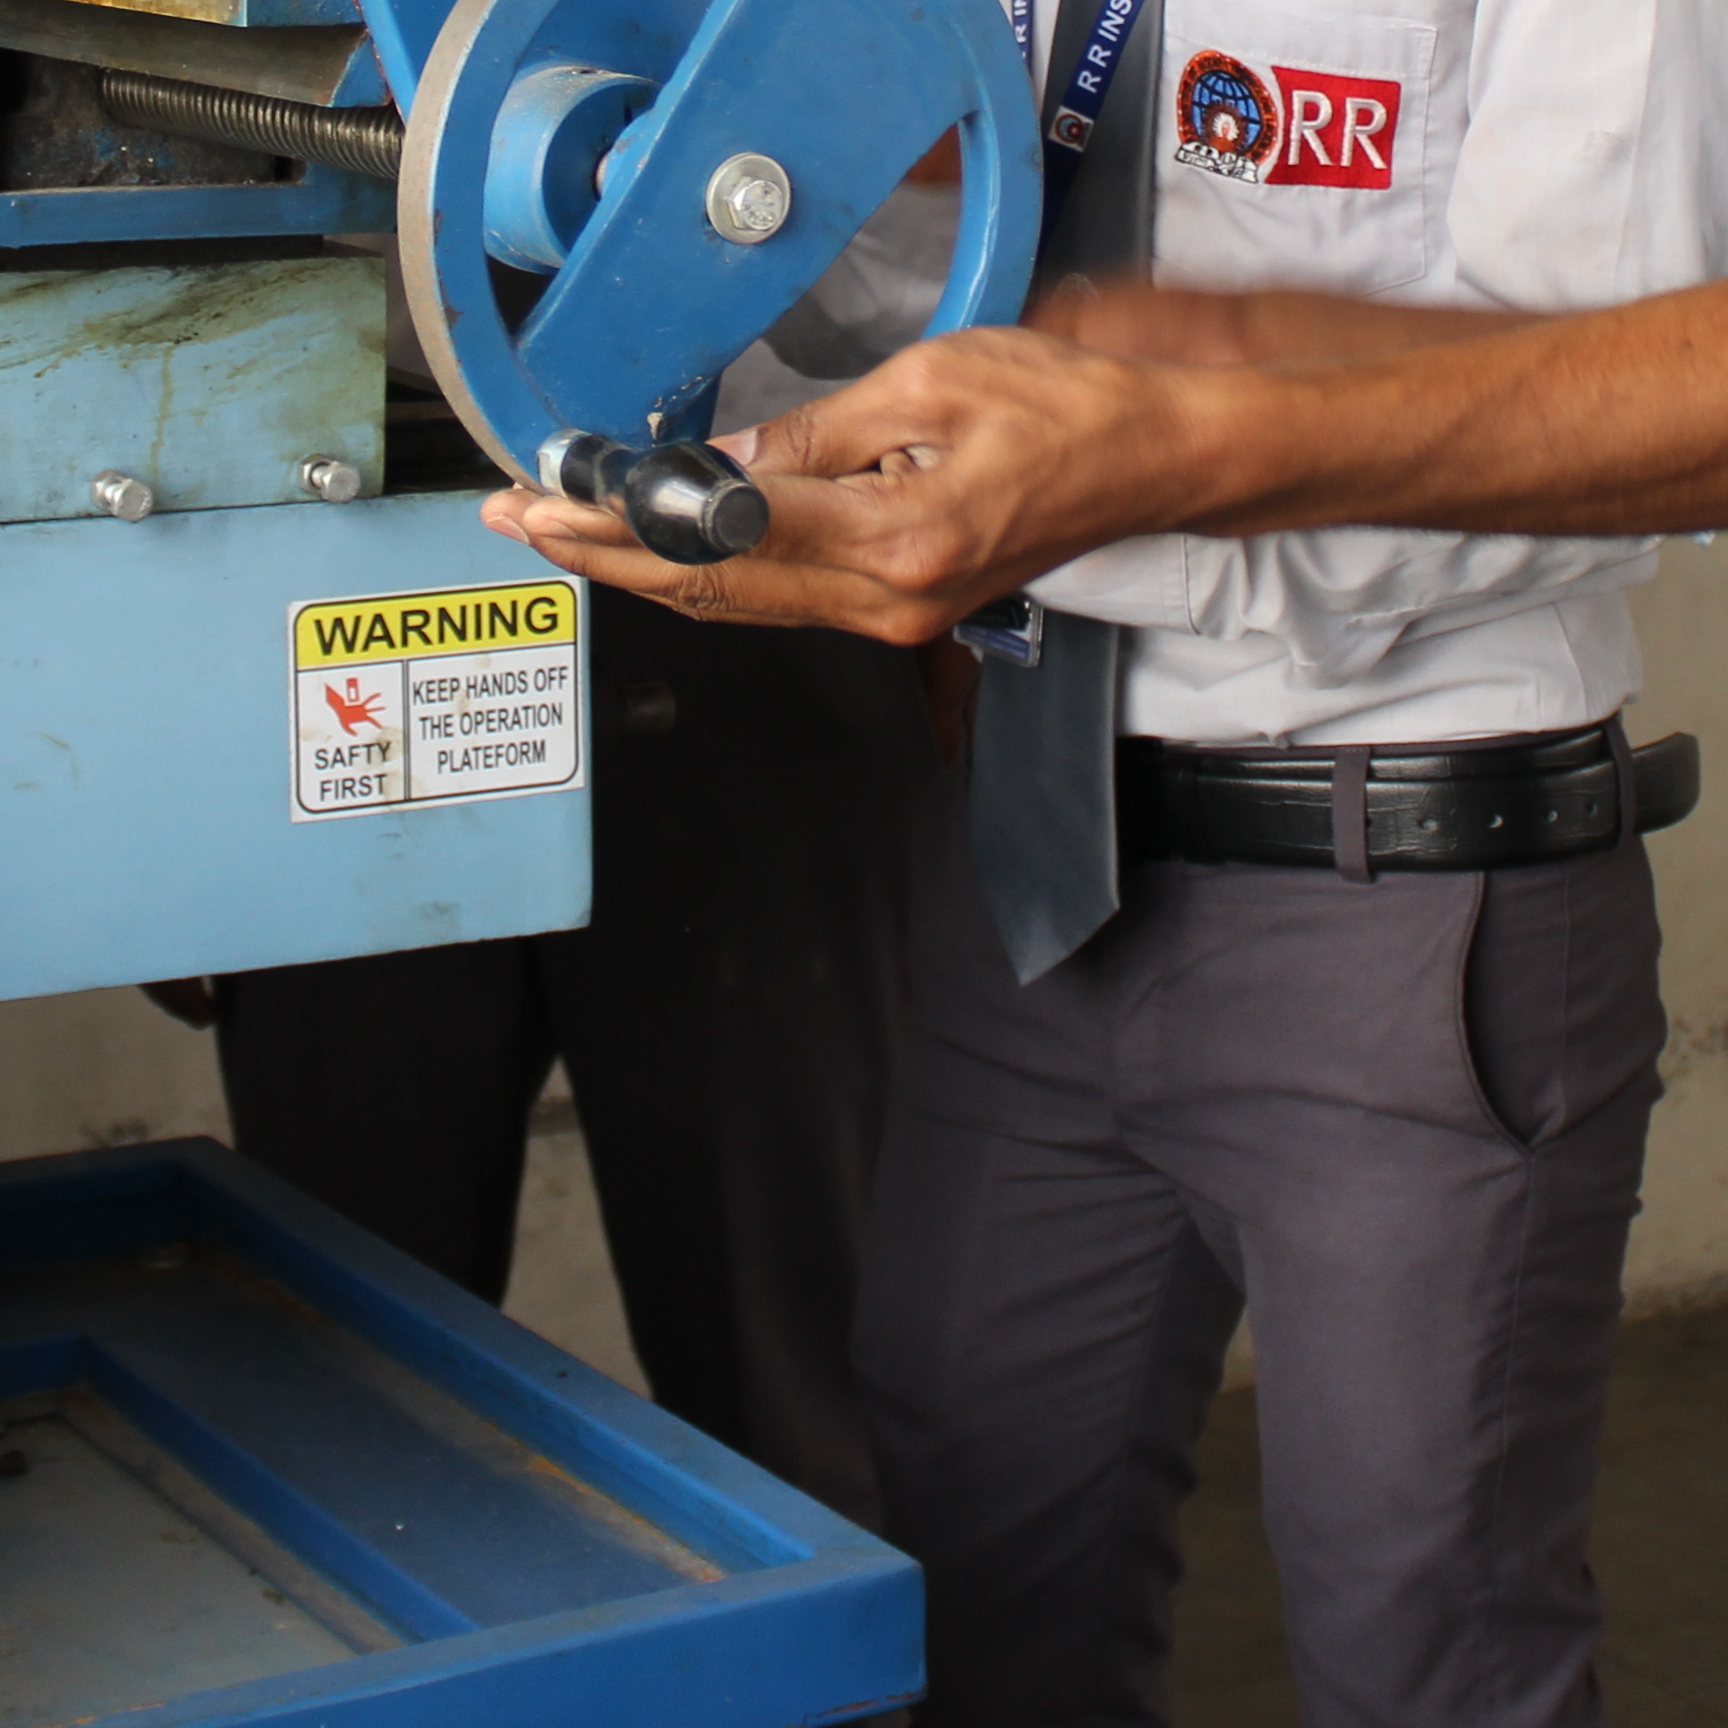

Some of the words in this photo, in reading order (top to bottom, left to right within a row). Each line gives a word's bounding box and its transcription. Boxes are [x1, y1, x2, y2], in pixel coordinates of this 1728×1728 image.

[1088, 44, 1112, 67] R
[1078, 71, 1102, 93] R
[1288, 90, 1388, 169] RR
[314, 597, 559, 656] WARNING
[413, 677, 460, 706] KEEP
[466, 670, 528, 700] HANDS
[533, 666, 568, 692] OFF
[419, 714, 454, 741] THE
[460, 703, 563, 736] OPERATION
[315, 742, 392, 770] SAFTY
[437, 739, 546, 774] PLATEFORM
[320, 773, 388, 802] FIRST
